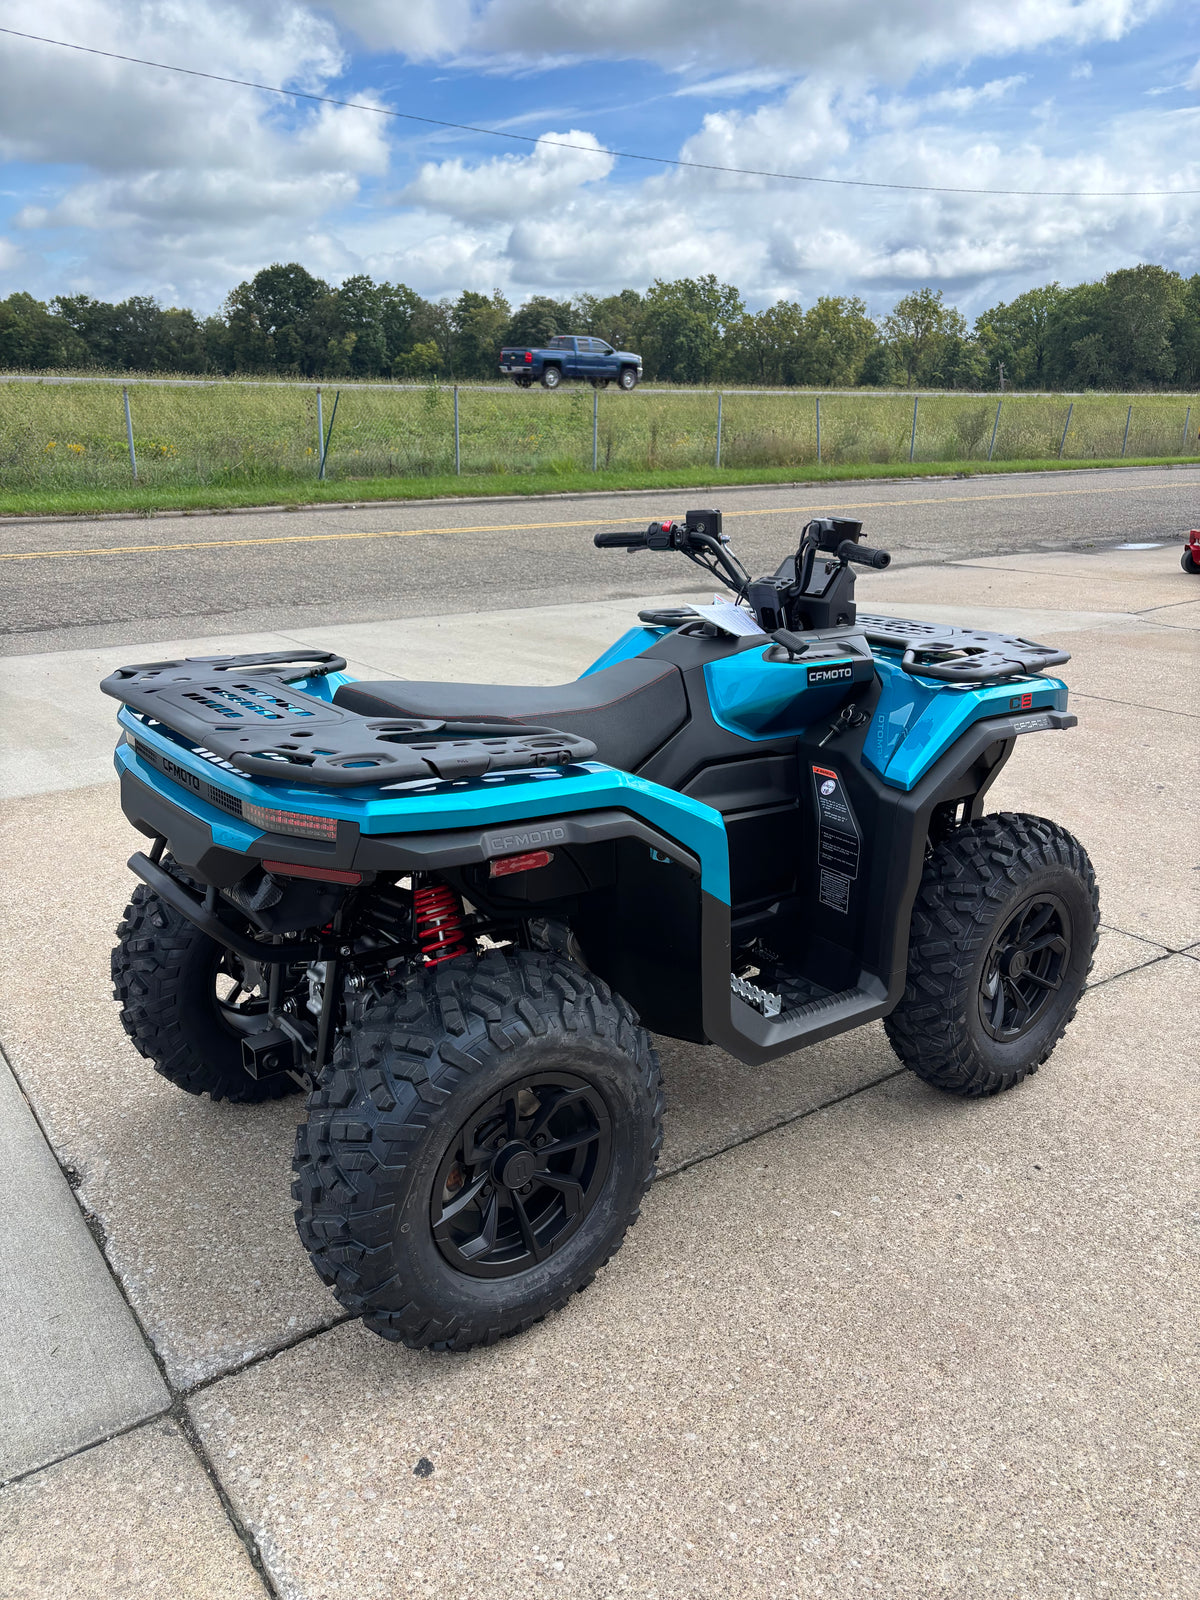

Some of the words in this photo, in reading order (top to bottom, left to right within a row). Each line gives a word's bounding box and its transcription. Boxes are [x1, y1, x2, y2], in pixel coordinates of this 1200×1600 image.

[809, 668, 852, 681] CFMOTO
[163, 757, 200, 790] CFMOTO
[492, 828, 565, 849] CFMOTO
